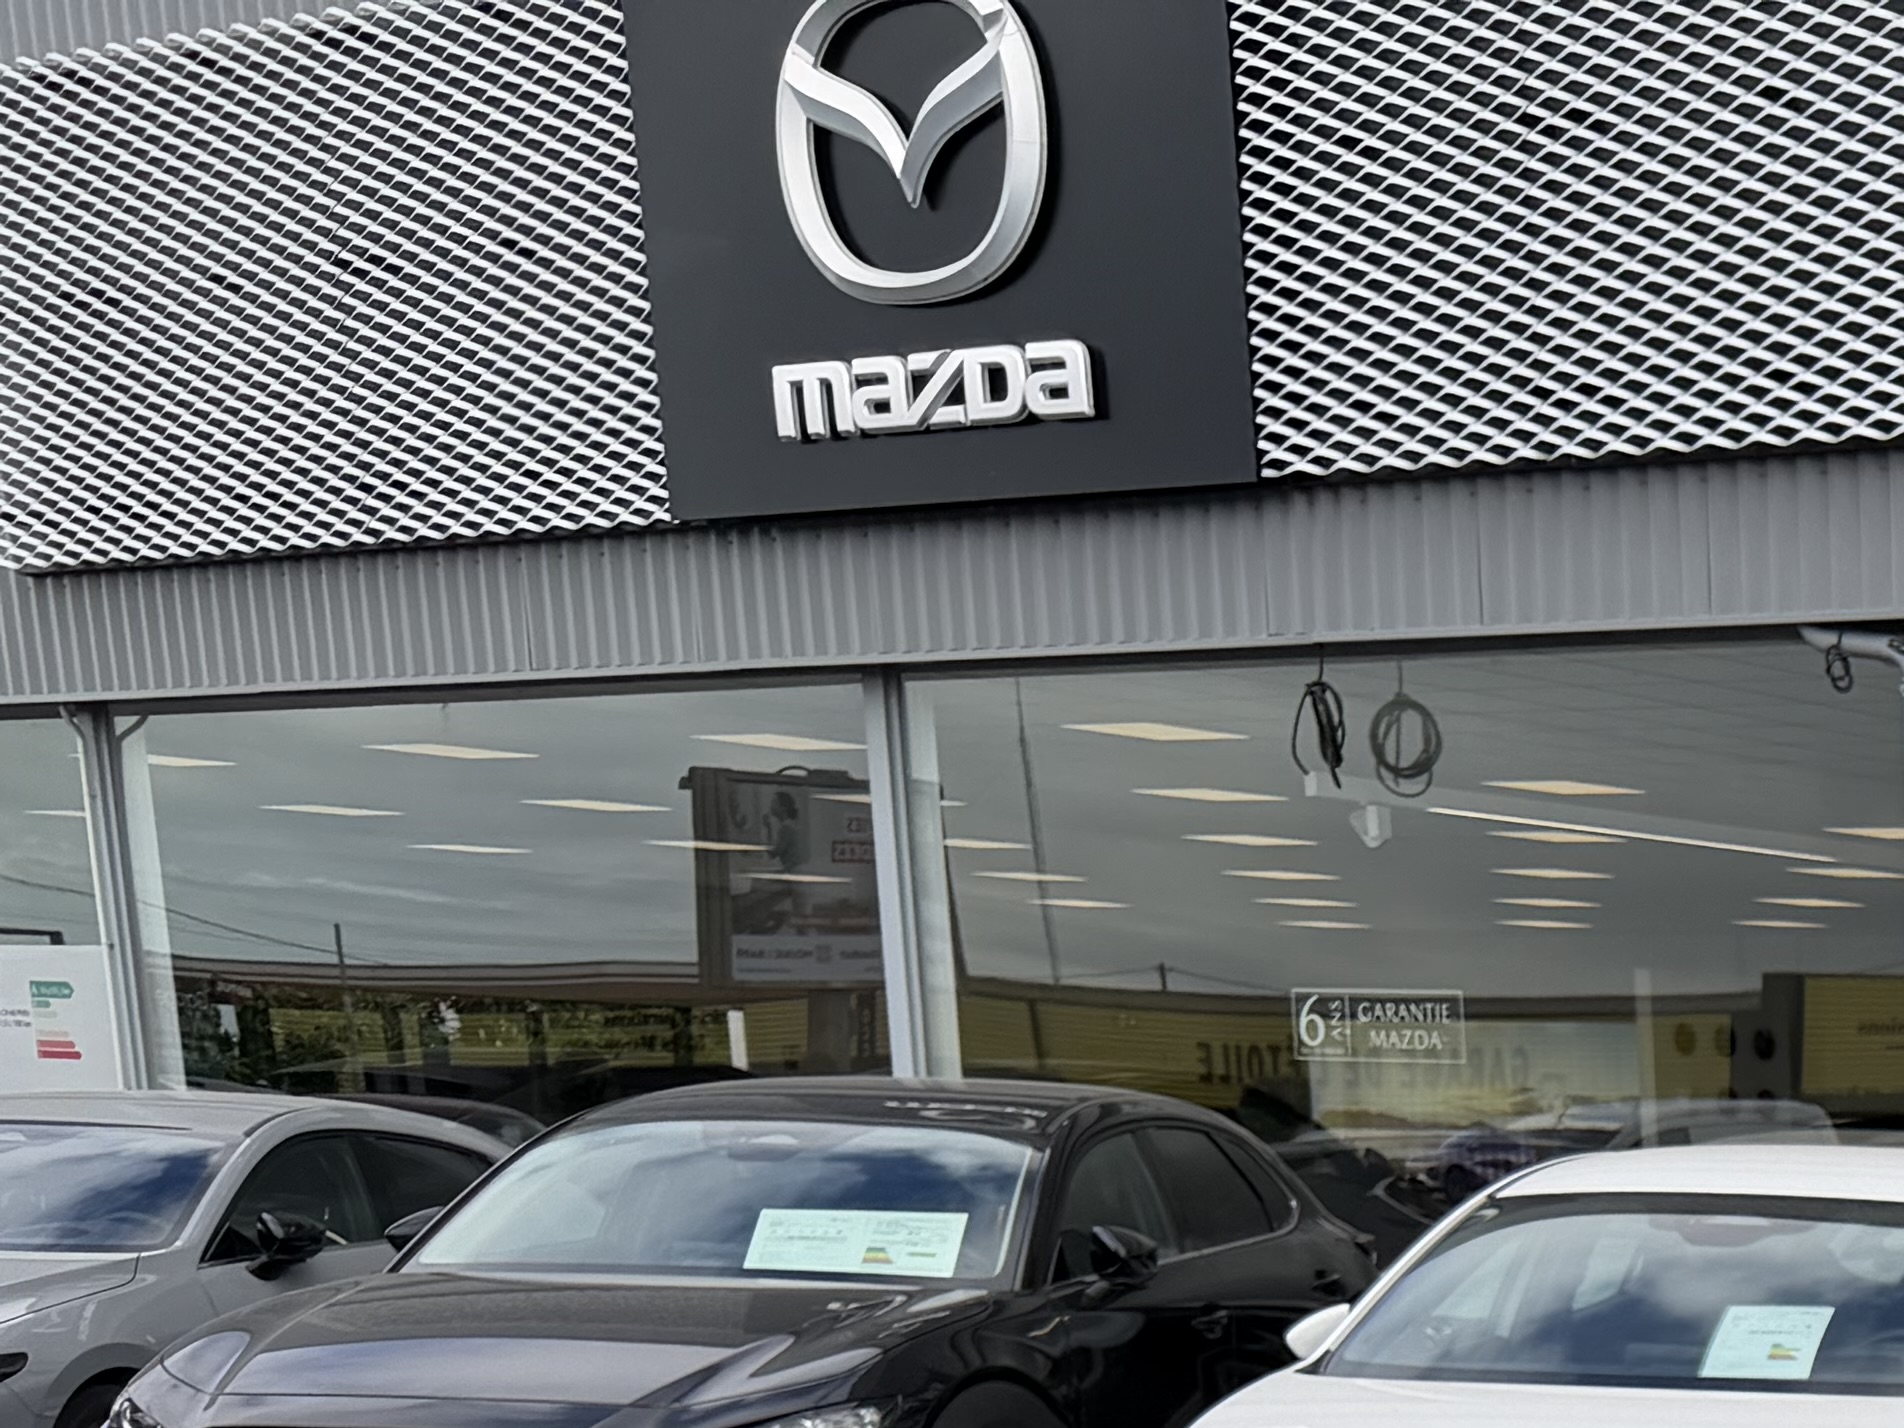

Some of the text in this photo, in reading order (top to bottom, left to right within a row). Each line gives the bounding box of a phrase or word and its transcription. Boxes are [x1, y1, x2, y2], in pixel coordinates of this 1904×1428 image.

[1299, 994, 1326, 1047] 6
[1357, 1002, 1451, 1024] GARANTIE
[1368, 1029, 1442, 1050] MAZDA
